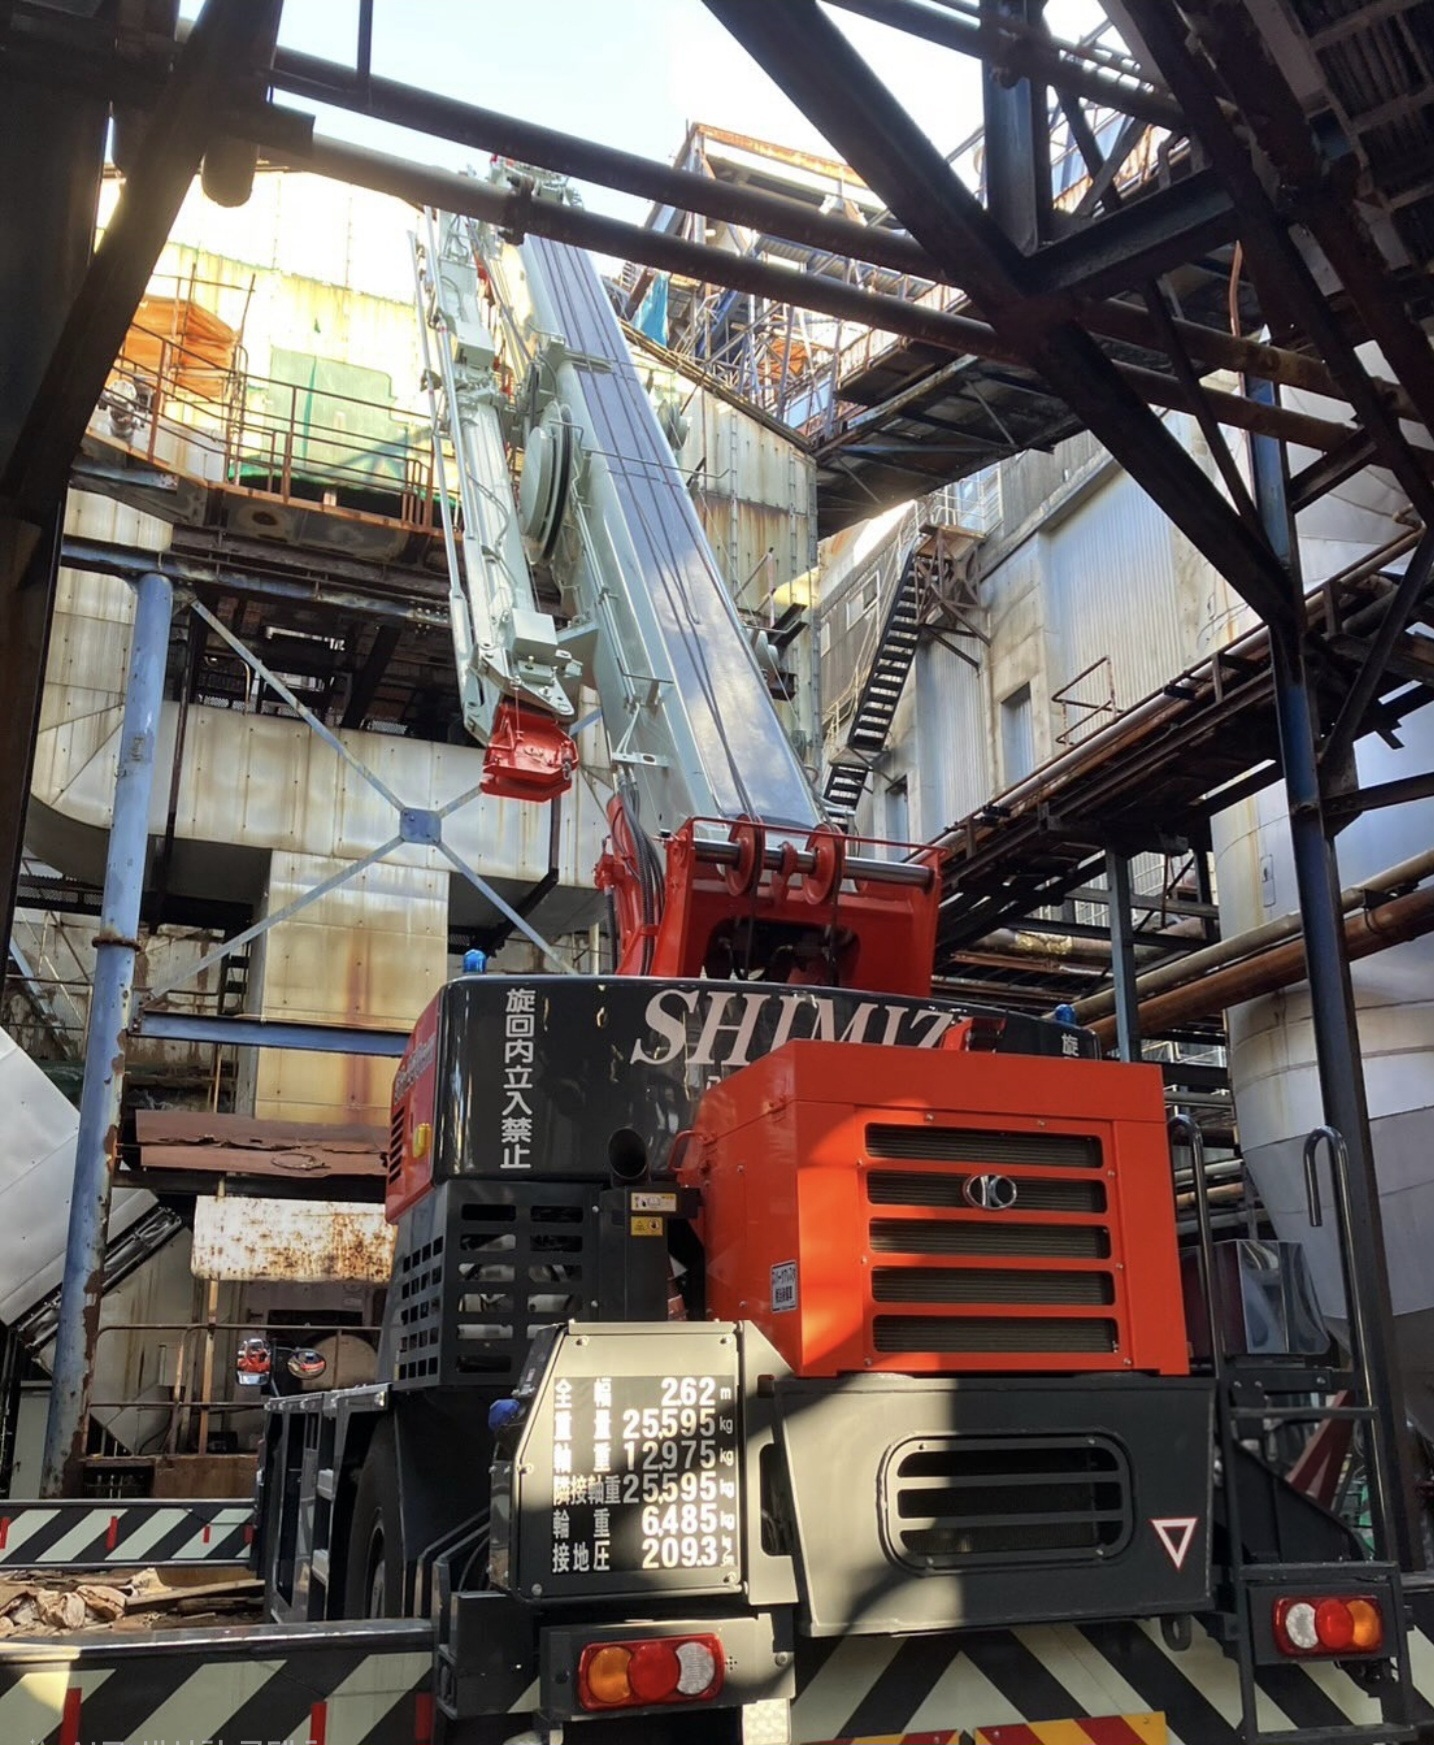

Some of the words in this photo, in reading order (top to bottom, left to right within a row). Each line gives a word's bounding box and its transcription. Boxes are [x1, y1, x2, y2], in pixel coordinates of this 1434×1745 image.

[630, 988, 974, 1066] SHIMIZ
[1061, 1033, 1079, 1058] 旋
[500, 988, 536, 1170] 旋回内立入禁止
[661, 1377, 715, 1406] 2.62
[623, 1408, 715, 1439] 25,595
[719, 1416, 733, 1434] kg
[623, 1440, 715, 1471] 12,975
[719, 1447, 734, 1466] kg
[623, 1472, 716, 1504] 25,595
[642, 1504, 717, 1536] 6,485
[552, 1541, 610, 1573] 接地圧
[642, 1536, 718, 1569] 209.3
